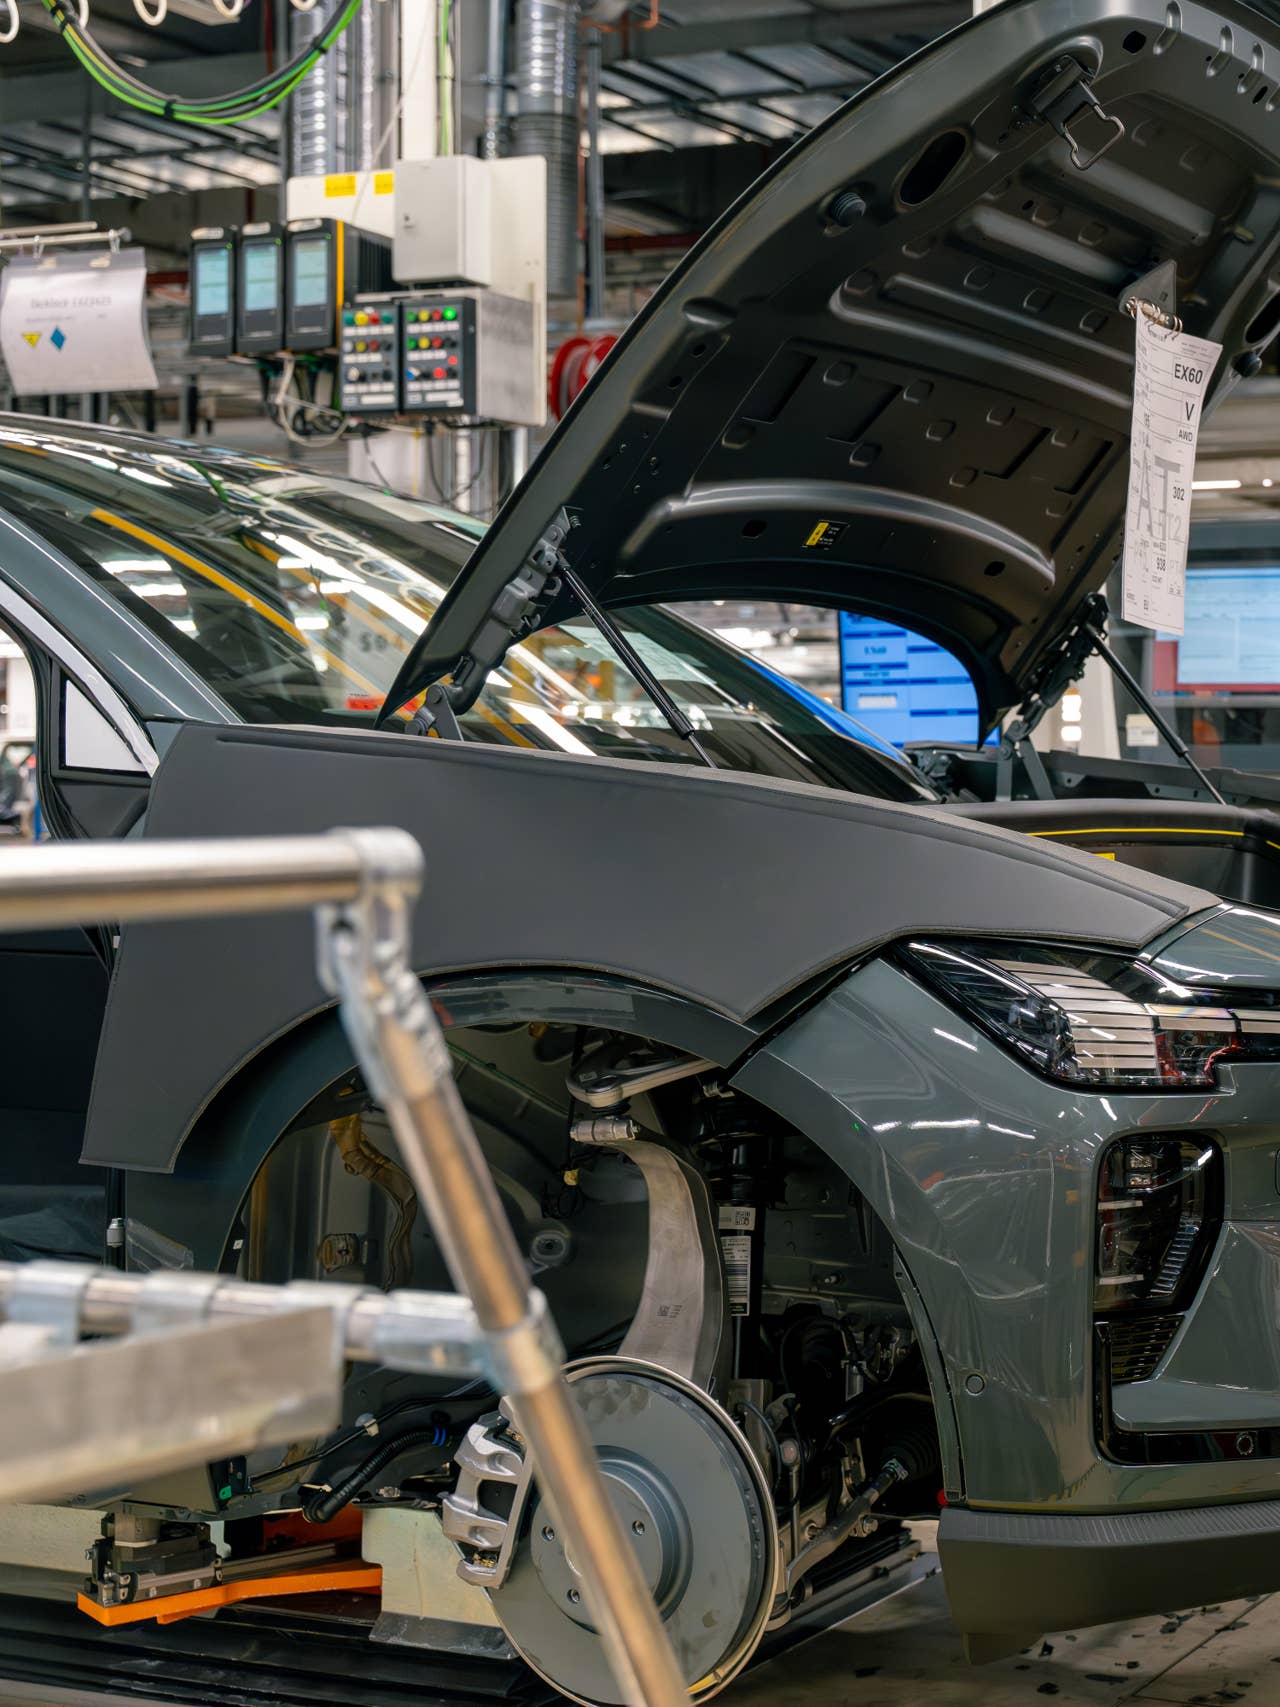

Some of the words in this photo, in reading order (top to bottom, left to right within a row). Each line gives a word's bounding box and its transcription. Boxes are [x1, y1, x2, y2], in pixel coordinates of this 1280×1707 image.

[1174, 363, 1203, 384] EX60
[1185, 401, 1195, 421] V
[1178, 428, 1193, 442] AWD
[1172, 485, 1185, 501] 302
